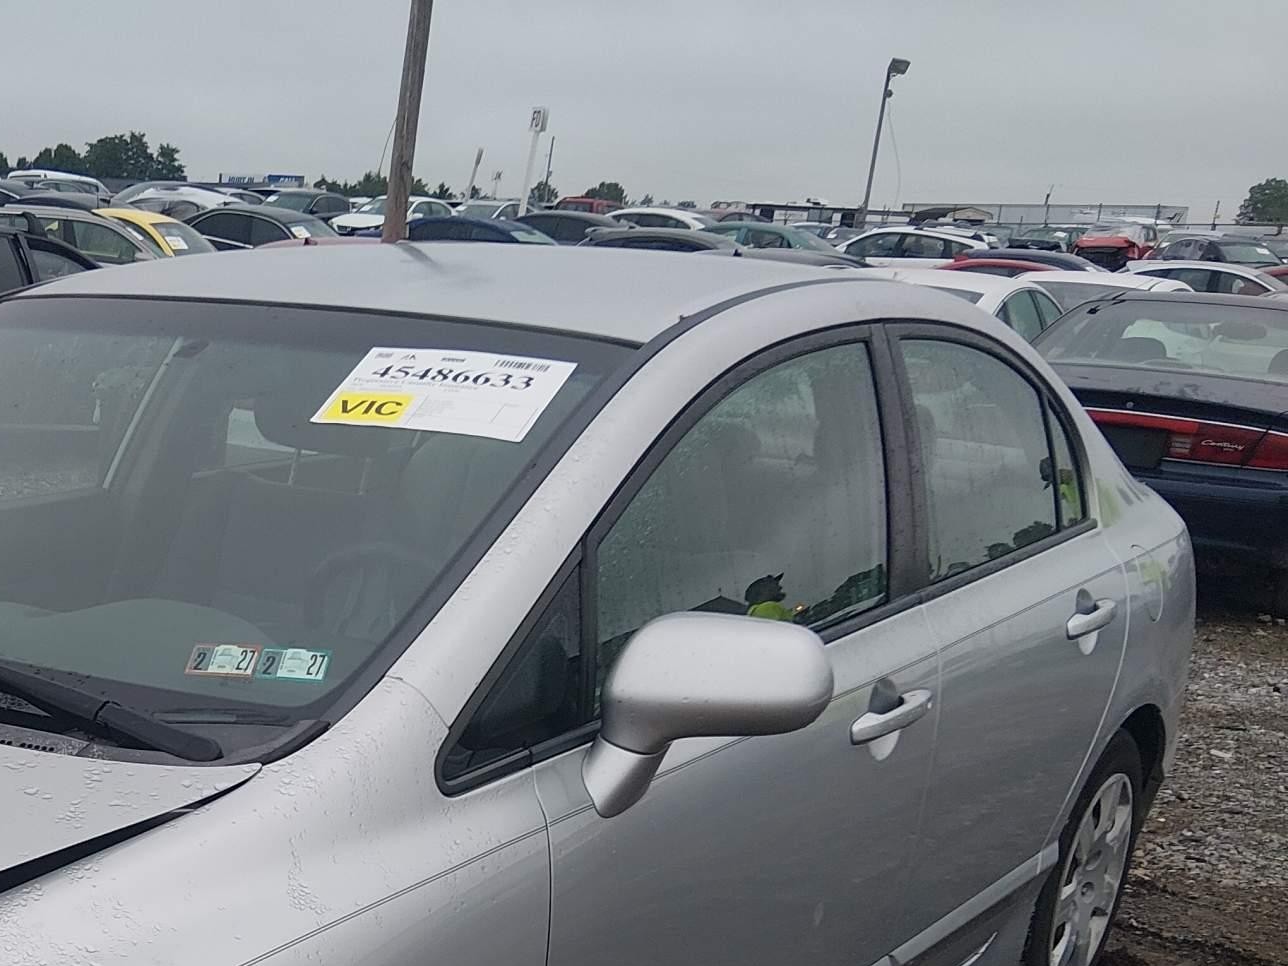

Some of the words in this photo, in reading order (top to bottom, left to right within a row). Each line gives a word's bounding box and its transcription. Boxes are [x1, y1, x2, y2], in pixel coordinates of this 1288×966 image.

[372, 364, 536, 391] 45486633
[340, 399, 403, 416] VIC
[193, 652, 207, 671] 2
[235, 650, 256, 672] 27
[262, 656, 277, 675] 2
[306, 654, 326, 677] 27
